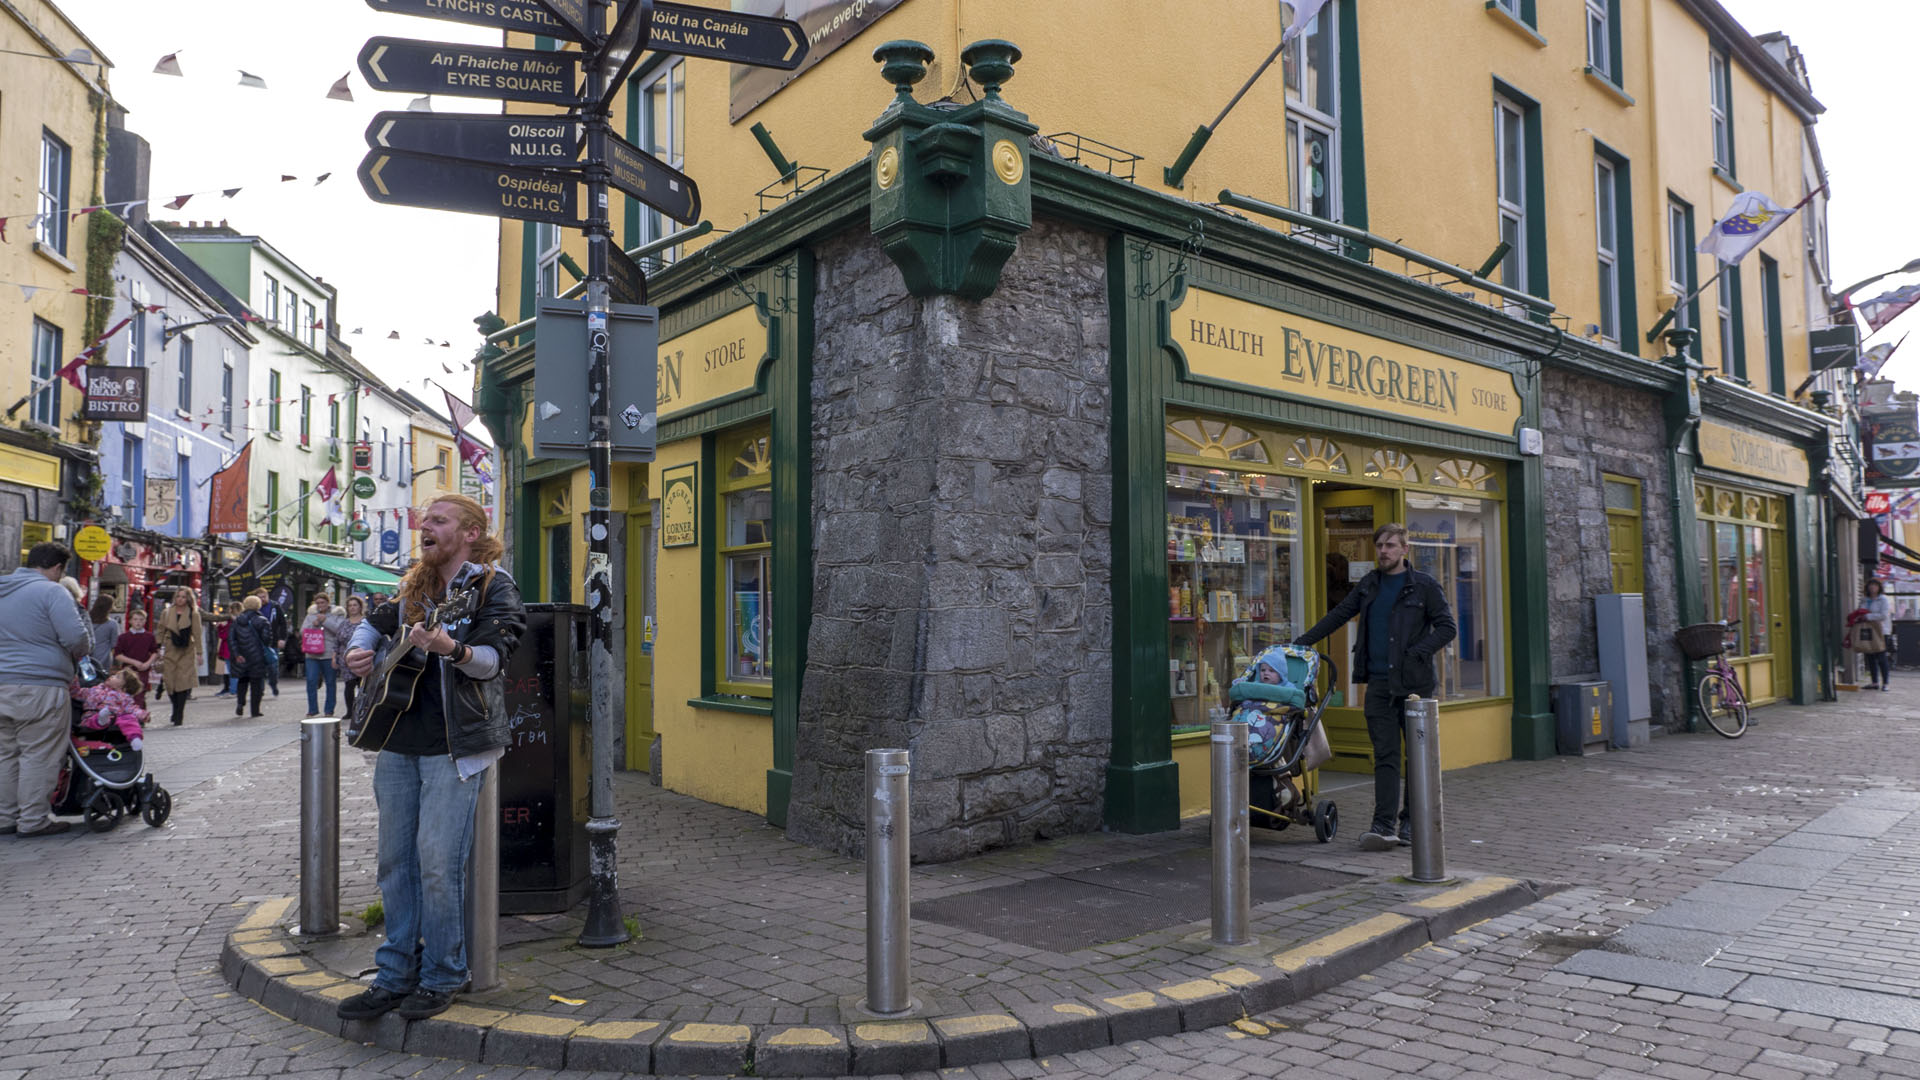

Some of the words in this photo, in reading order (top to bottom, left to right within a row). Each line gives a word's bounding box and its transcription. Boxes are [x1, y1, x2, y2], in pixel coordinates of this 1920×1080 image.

[682, 17, 698, 28] na
[703, 17, 749, 36] Canála
[684, 32, 726, 50] WALK
[431, 53, 453, 66] An
[458, 54, 519, 71] Fhaiche
[522, 60, 562, 75] Mhór
[447, 72, 491, 87] EYRE
[495, 76, 563, 93] SQUARE
[509, 125, 565, 138] Ollscoil
[510, 143, 566, 156] N.U.I.G.
[498, 174, 564, 195] Ospidéal
[613, 164, 647, 191] MUSEUM
[502, 193, 565, 213] U.C.H.G.
[704, 338, 746, 373] STORE
[1189, 318, 1264, 357] HEALTH
[1281, 326, 1458, 415] EVERGREEN
[1471, 387, 1508, 412] STORE
[88, 400, 140, 413] BISTRO
[666, 521, 692, 535] CORNER
